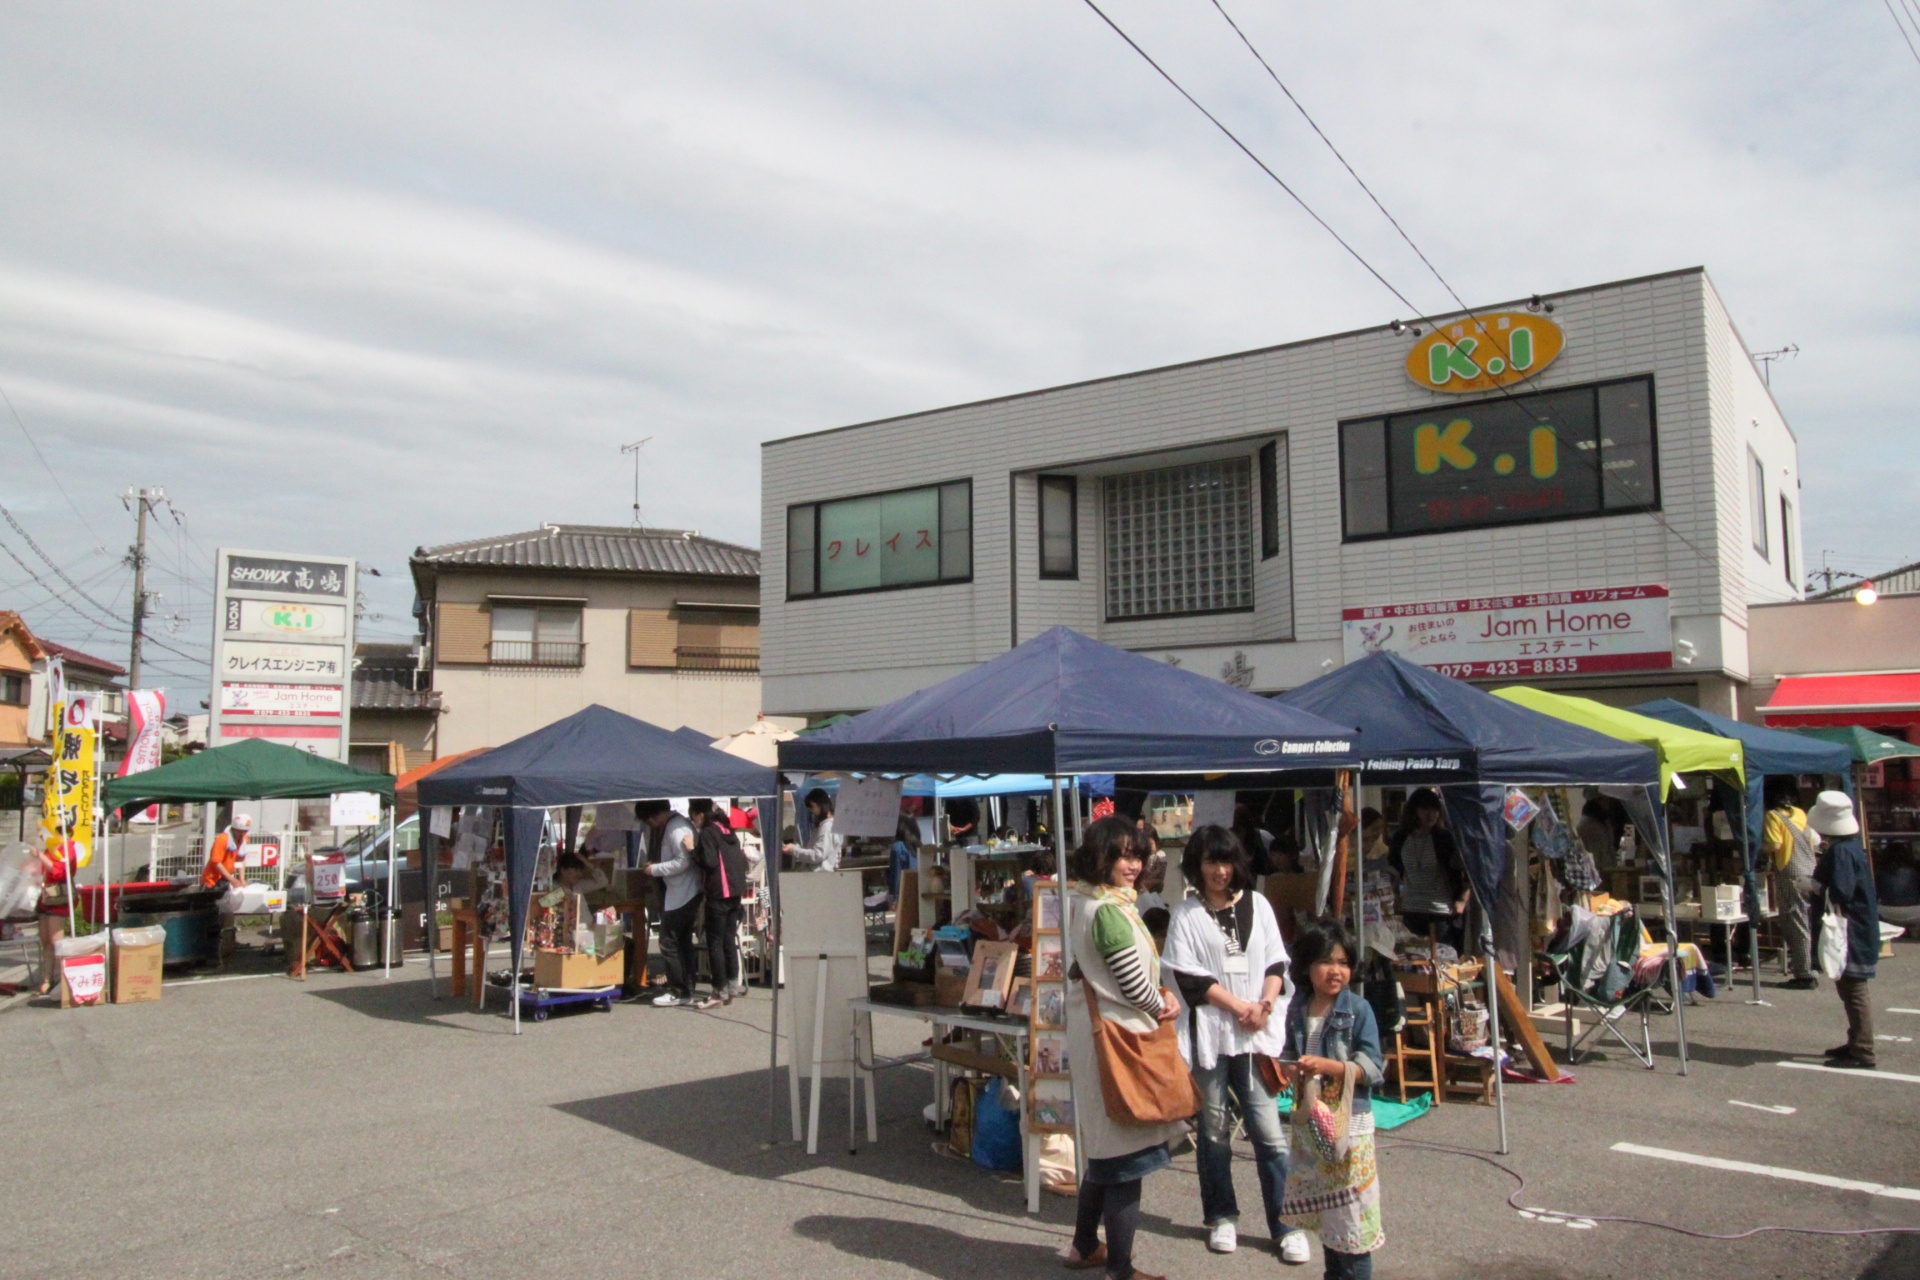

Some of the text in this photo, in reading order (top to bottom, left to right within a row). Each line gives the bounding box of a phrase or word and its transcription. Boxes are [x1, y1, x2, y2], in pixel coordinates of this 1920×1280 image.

[1428, 326, 1534, 385] K.I
[1412, 417, 1559, 479] K.I
[826, 528, 933, 560] クレイス
[230, 566, 292, 584] SHOWX
[228, 600, 240, 630] 202
[273, 611, 313, 629] K.I
[1479, 609, 1632, 639] Jam Home
[1407, 617, 1456, 634] お住まいの
[1419, 631, 1457, 646] ことなら
[1518, 637, 1599, 656] エステート
[274, 691, 299, 701] Jam
[300, 691, 334, 702] Home
[1281, 740, 1351, 754] Campers Collection
[262, 845, 278, 866] P
[316, 873, 339, 887] 250
